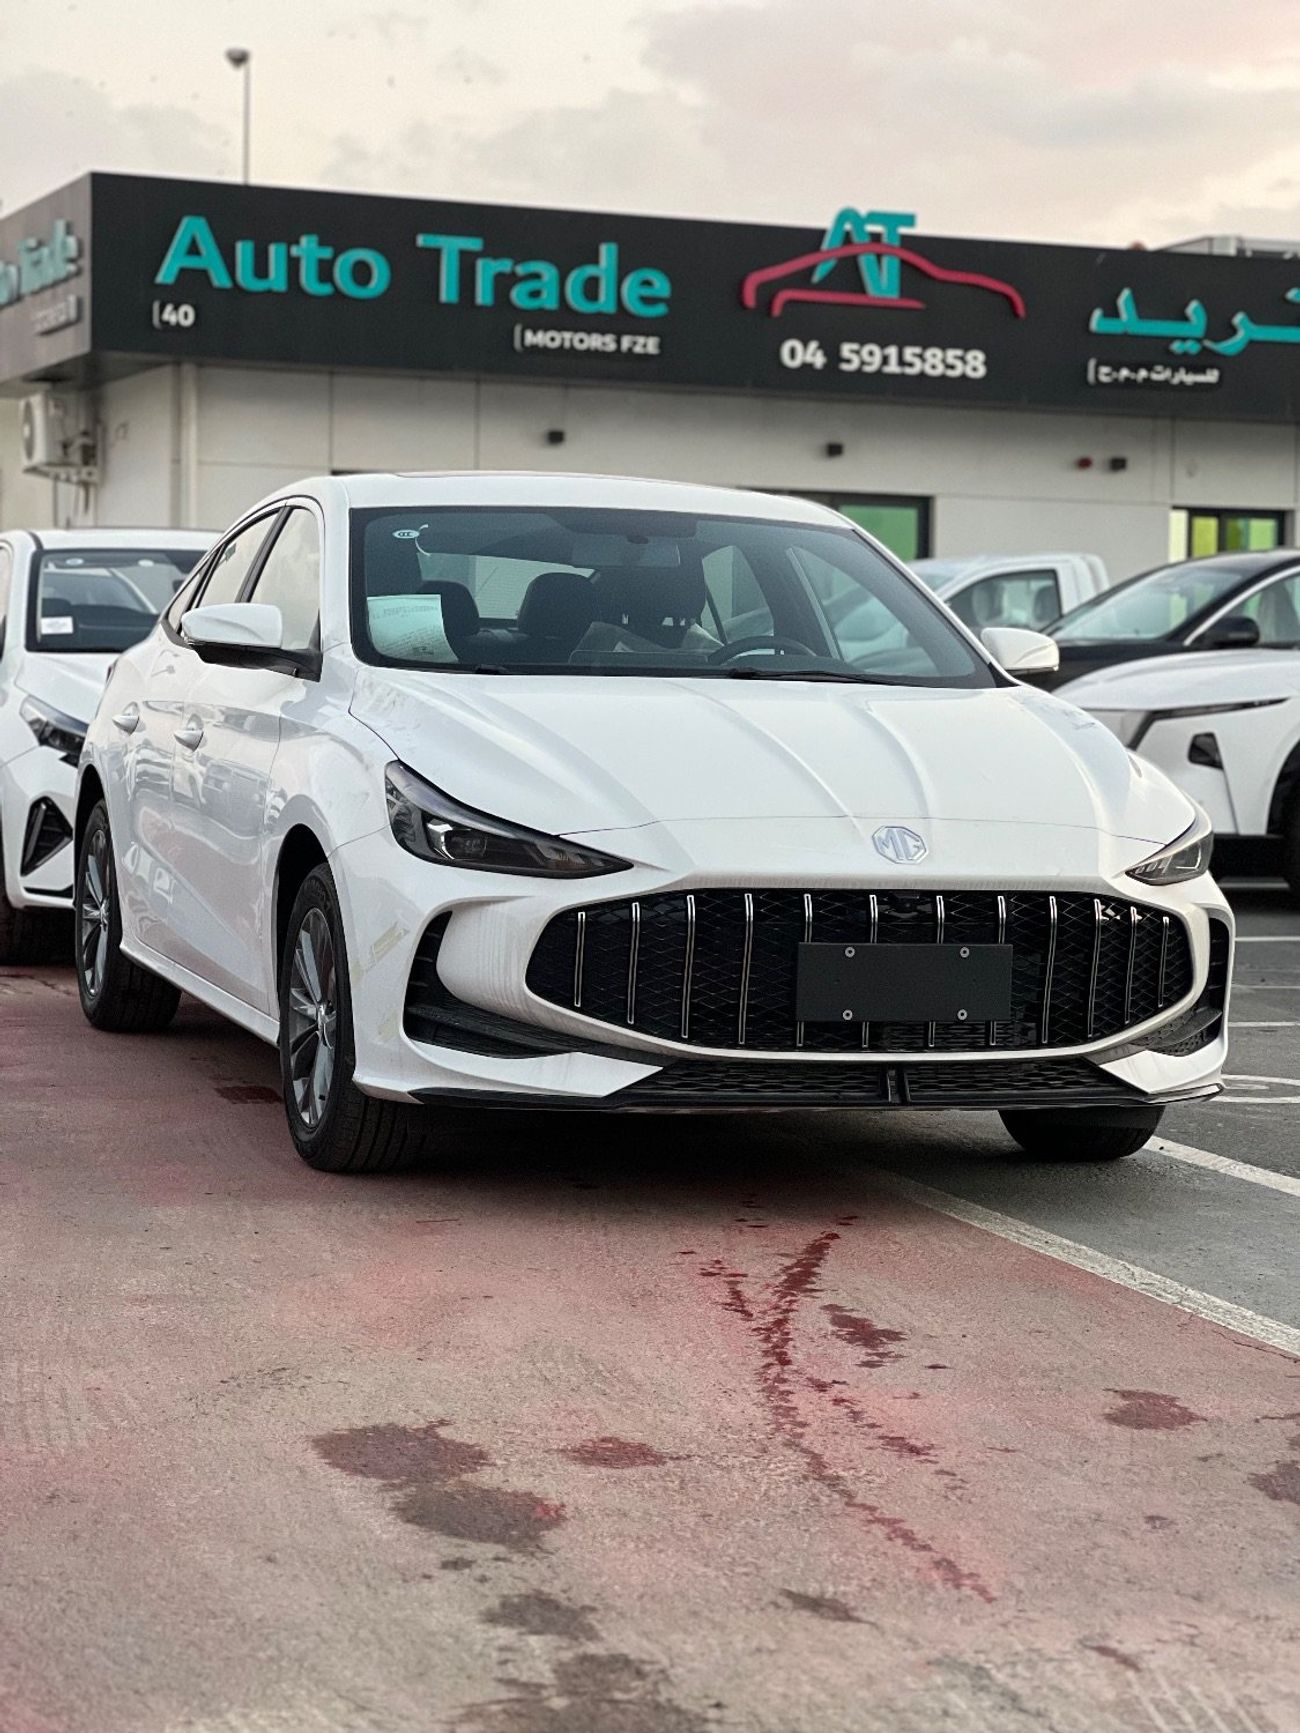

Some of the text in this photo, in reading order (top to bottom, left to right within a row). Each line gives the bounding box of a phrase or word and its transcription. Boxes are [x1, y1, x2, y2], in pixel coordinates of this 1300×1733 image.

[155, 214, 672, 319] Auto Trade
[811, 207, 917, 299] AT
[620, 334, 660, 356] FZE
[780, 338, 987, 379] 04 5915858
[875, 828, 925, 861] MG
